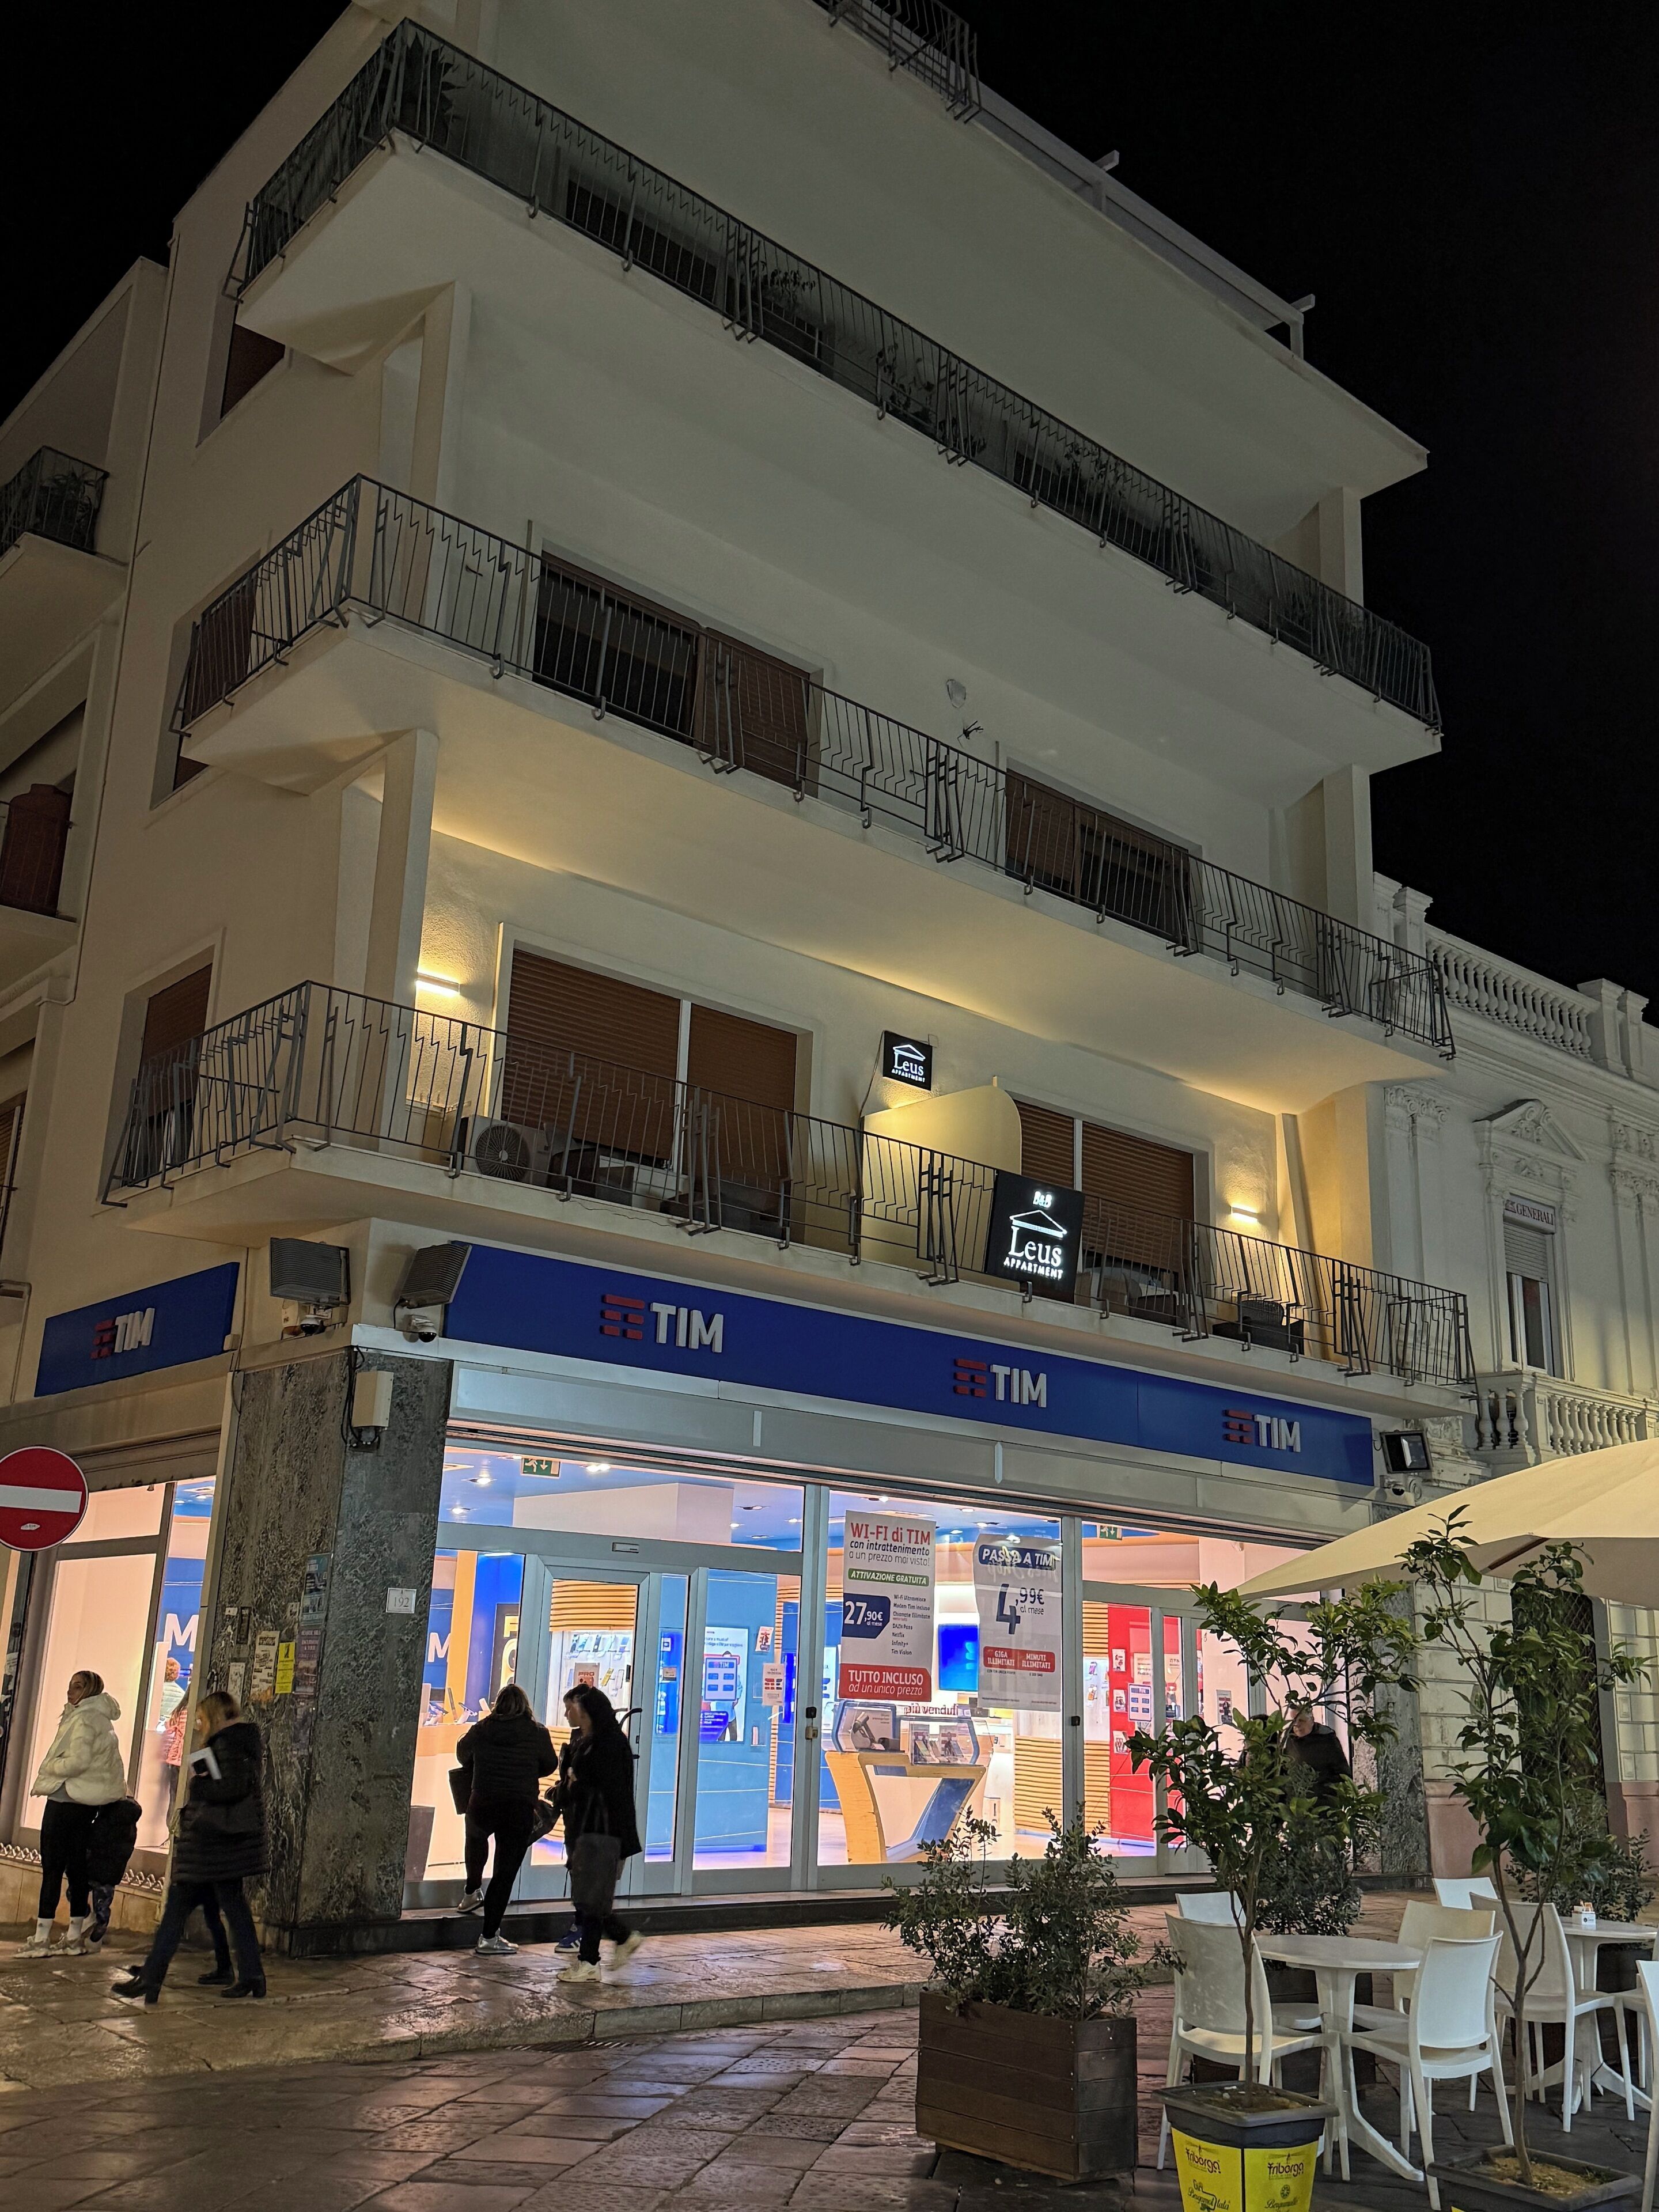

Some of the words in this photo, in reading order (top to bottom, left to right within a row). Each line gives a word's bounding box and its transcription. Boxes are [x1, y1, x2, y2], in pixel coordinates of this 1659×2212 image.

[893, 1052, 924, 1076] Leus
[1033, 1191, 1052, 1208] B&B
[1516, 1203, 1554, 1225] GENERALI
[1008, 1225, 1062, 1267] Leus
[1003, 1256, 1063, 1280] APPARTMENT
[114, 1307, 155, 1353] TIM
[650, 1302, 724, 1353] TIM
[990, 1364, 1047, 1408] TIM
[1254, 1414, 1301, 1452] TIM
[850, 1522, 888, 1541] WI-FI
[892, 1527, 903, 1543] di
[907, 1529, 930, 1546] TIM
[850, 1540, 864, 1550] con
[866, 1540, 930, 1556] intrattenimento
[856, 1552, 866, 1560] un
[868, 1553, 893, 1563] prezzo
[895, 1555, 908, 1564] mai
[910, 1557, 930, 1567] visto!
[1023, 1552, 1032, 1565] A
[1035, 1553, 1052, 1566] TIM
[851, 1571, 895, 1582] ATTIVAZIONE
[896, 1575, 926, 1585] GRATUITA
[394, 1597, 410, 1607] 192
[1020, 1605, 1026, 1613] al
[987, 1657, 1015, 1666] ILLIMITATI
[994, 1650, 1007, 1658] GIGA
[1026, 1653, 1046, 1661] MINUTI
[1022, 1660, 1051, 1669] ILLIMITATI
[849, 1670, 880, 1683] TUTTO
[882, 1672, 923, 1685] INCLUSO
[849, 1681, 859, 1692] ad
[861, 1684, 872, 1693] un
[874, 1685, 895, 1694] unico
[897, 1687, 922, 1698] prezzo
